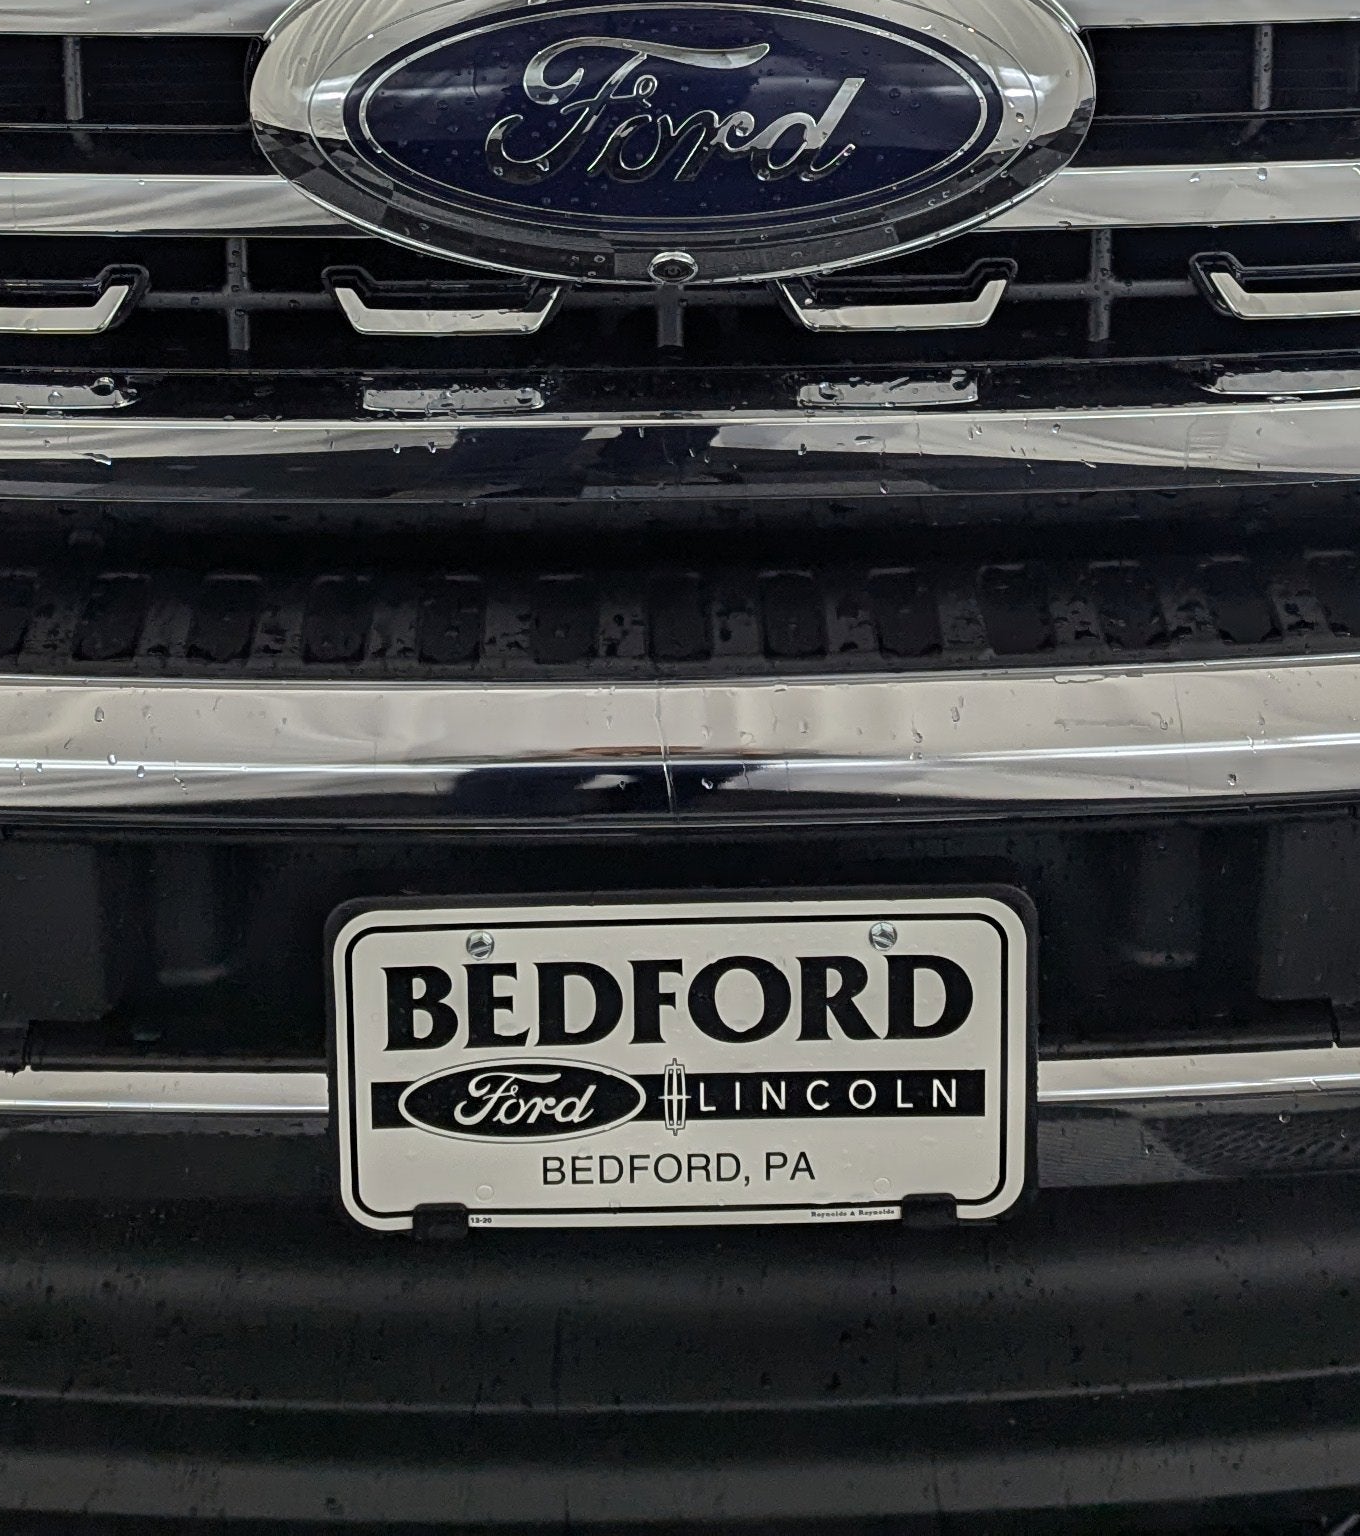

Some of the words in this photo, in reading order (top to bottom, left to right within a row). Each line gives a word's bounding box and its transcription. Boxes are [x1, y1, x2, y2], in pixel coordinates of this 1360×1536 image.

[485, 36, 865, 182] Ford
[382, 955, 974, 1052] BEDFORD
[454, 1072, 596, 1126] Ford
[698, 1078, 960, 1113] LINCOLN
[542, 1154, 751, 1187] BEDFORD,
[765, 1151, 816, 1181] PA
[811, 1211, 847, 1219] Reynolds
[858, 1209, 895, 1217] Reynolds
